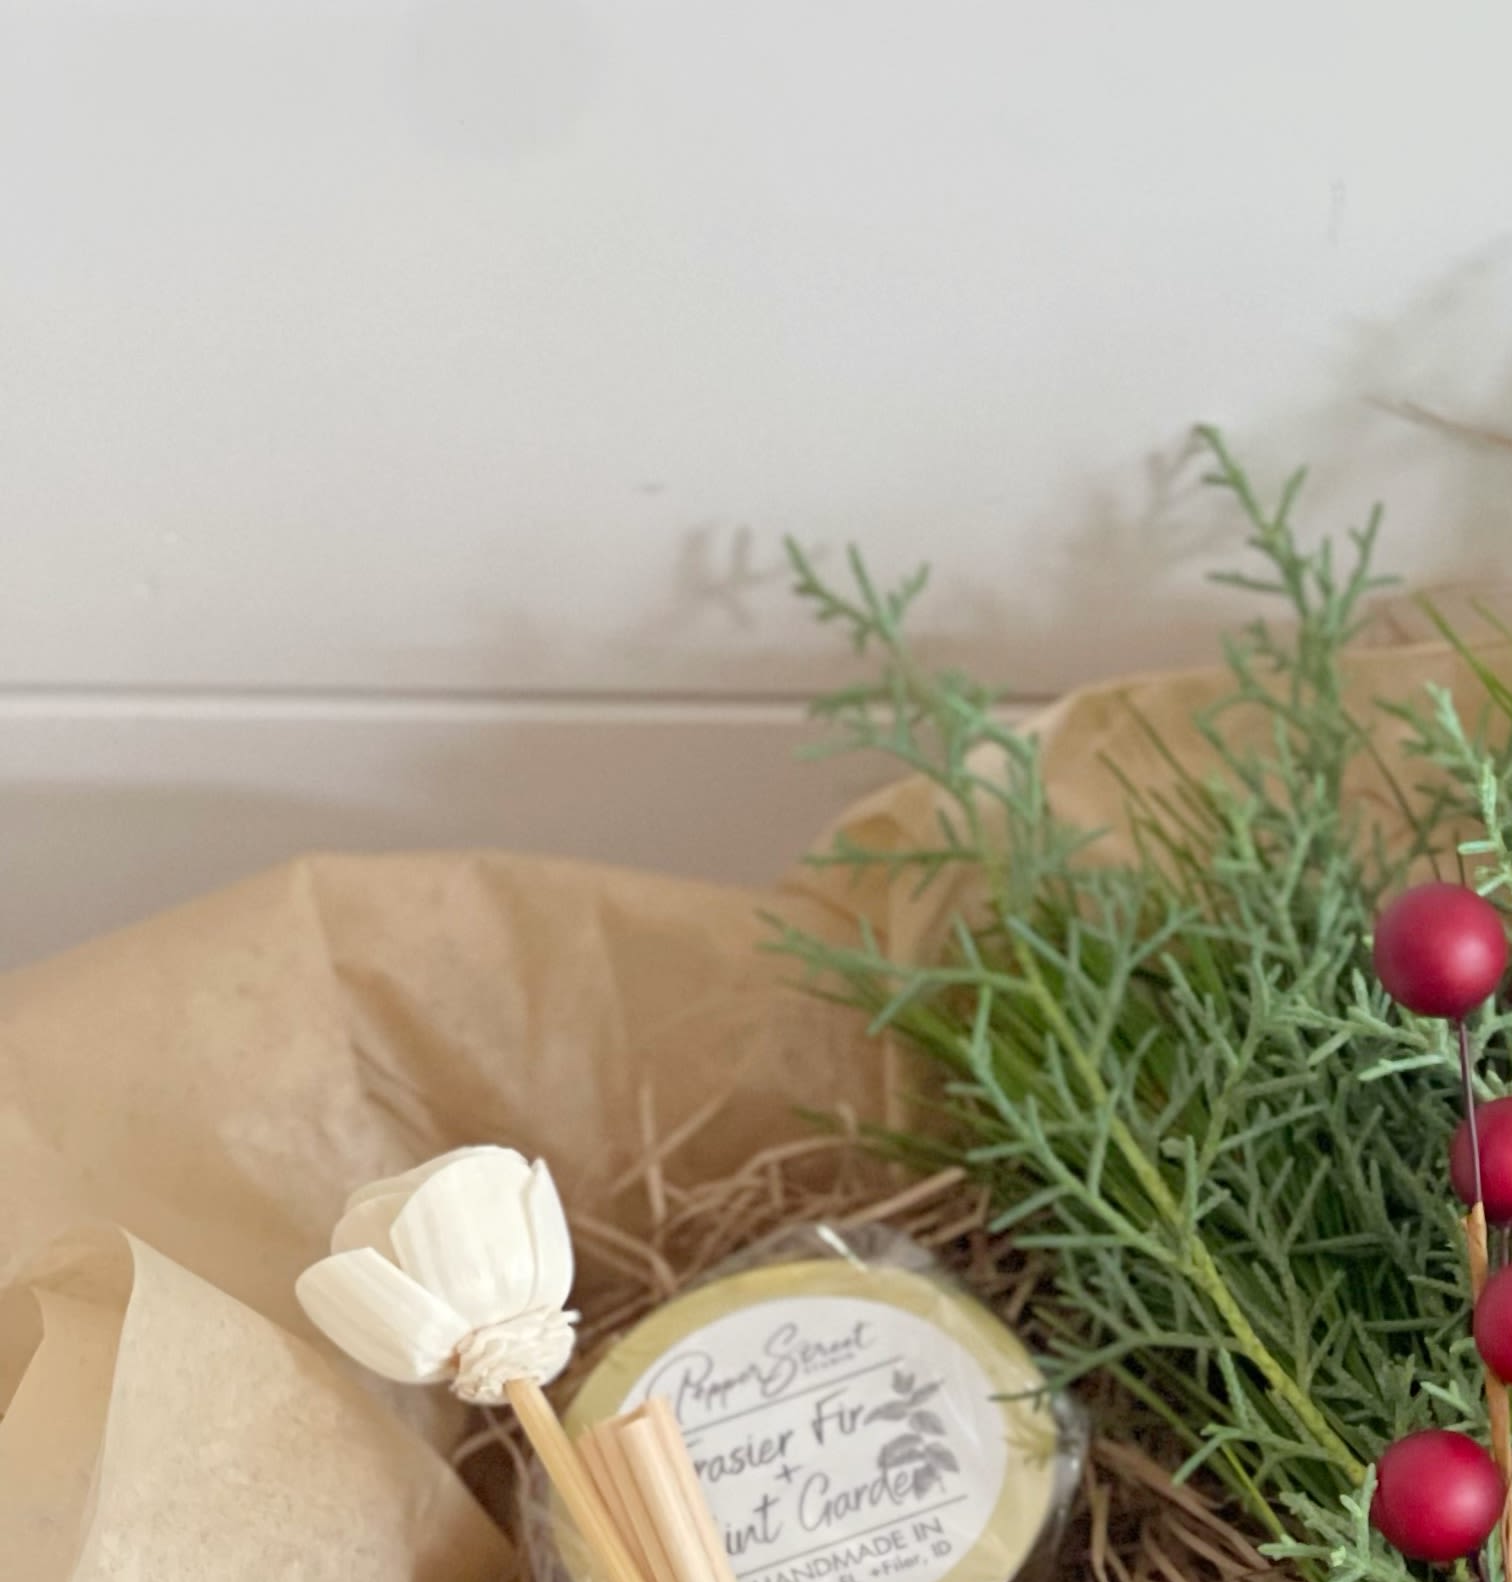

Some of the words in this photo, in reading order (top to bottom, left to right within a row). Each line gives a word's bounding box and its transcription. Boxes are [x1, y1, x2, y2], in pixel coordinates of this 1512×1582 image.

[685, 1429, 794, 1483] rasier
[811, 1387, 865, 1446] Fir
[713, 1493, 784, 1557] int
[912, 1516, 945, 1543] IN
[931, 1539, 953, 1560] ID
